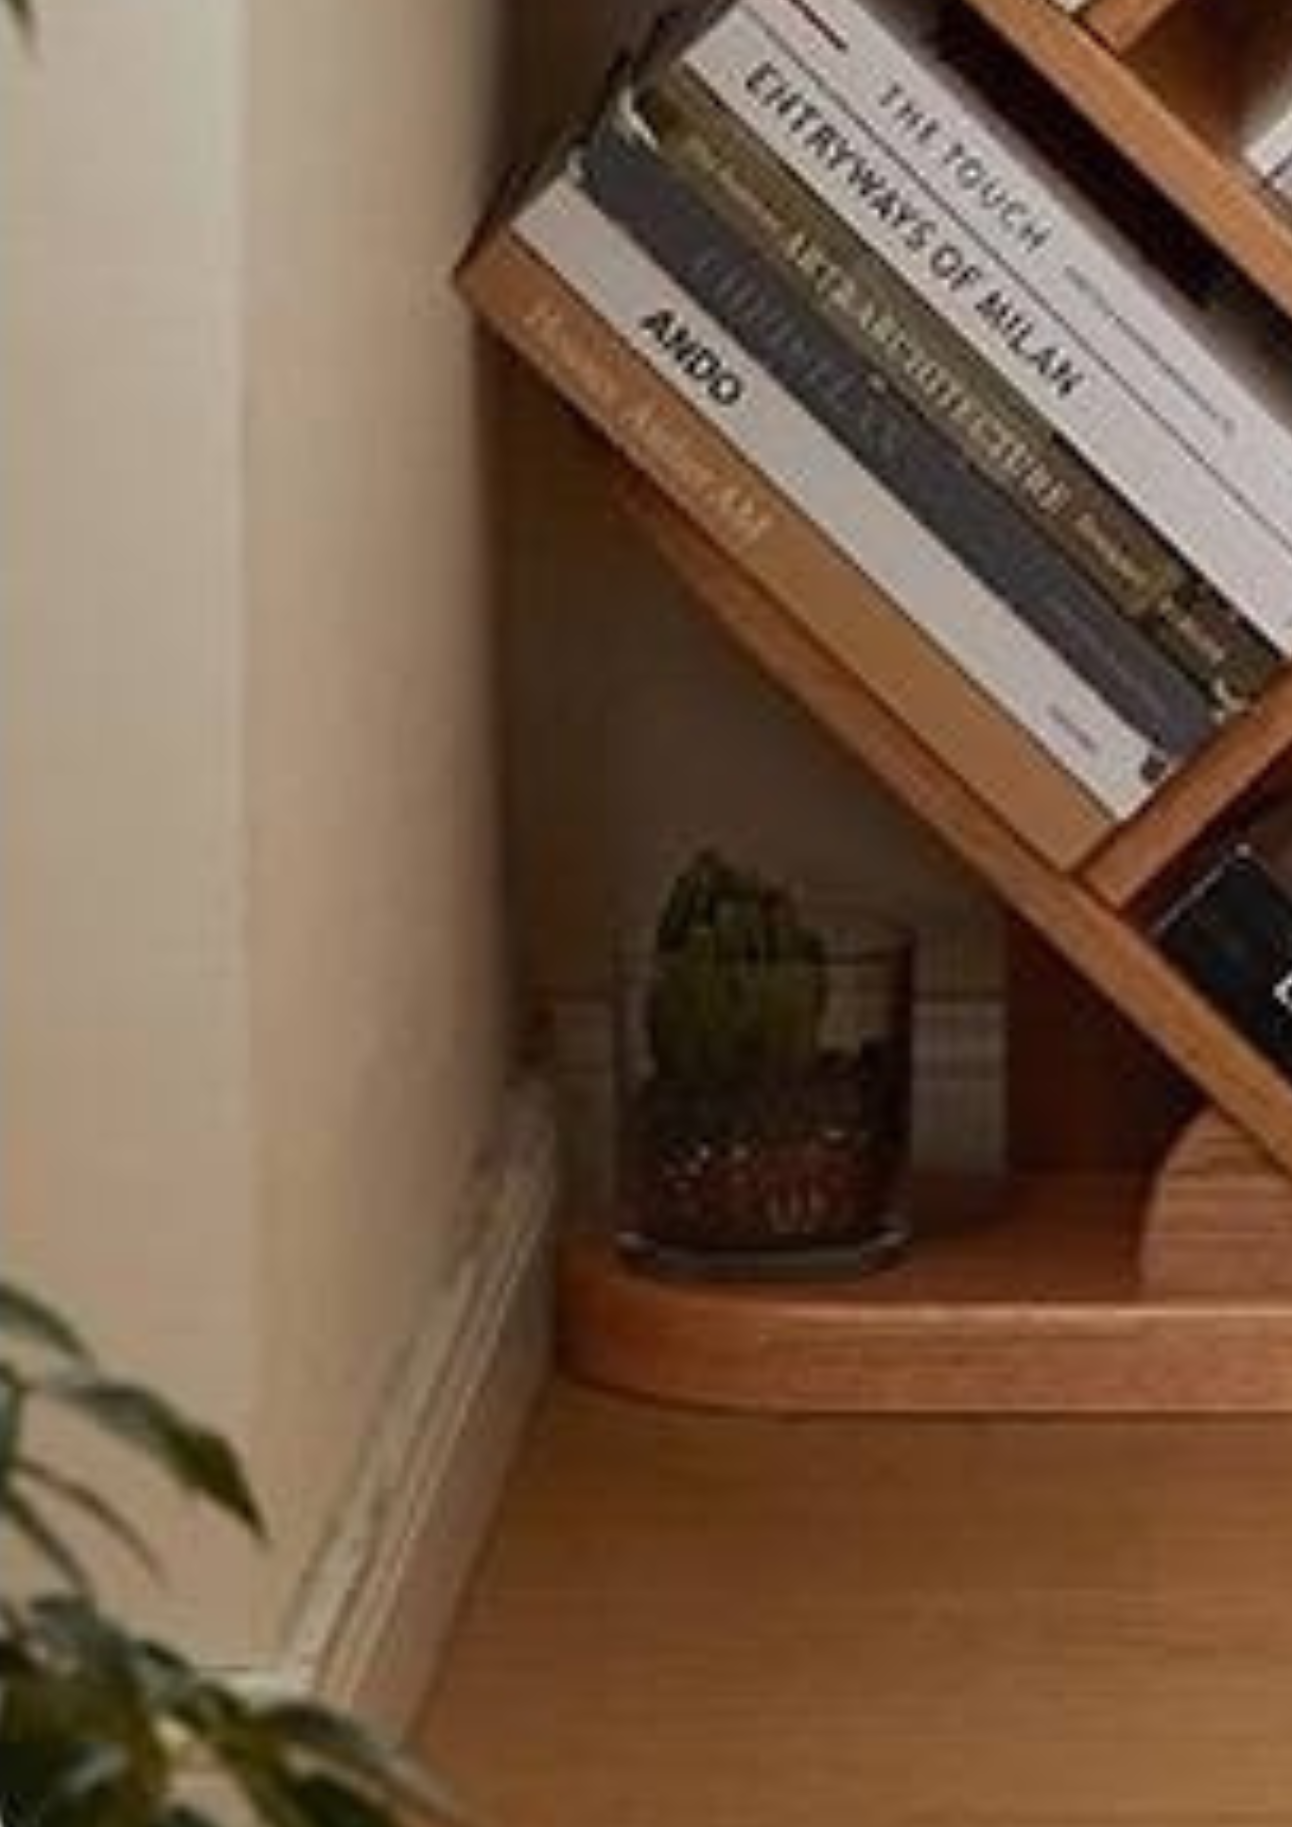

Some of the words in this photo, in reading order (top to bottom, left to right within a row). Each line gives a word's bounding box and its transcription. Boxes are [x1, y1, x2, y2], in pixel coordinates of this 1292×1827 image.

[739, 61, 938, 257] ENTRYWAYS
[921, 240, 987, 305] OF
[969, 288, 1086, 403] MILAN
[873, 79, 946, 154] THE
[932, 139, 1053, 257] TOUCH
[636, 300, 749, 413] ANDO
